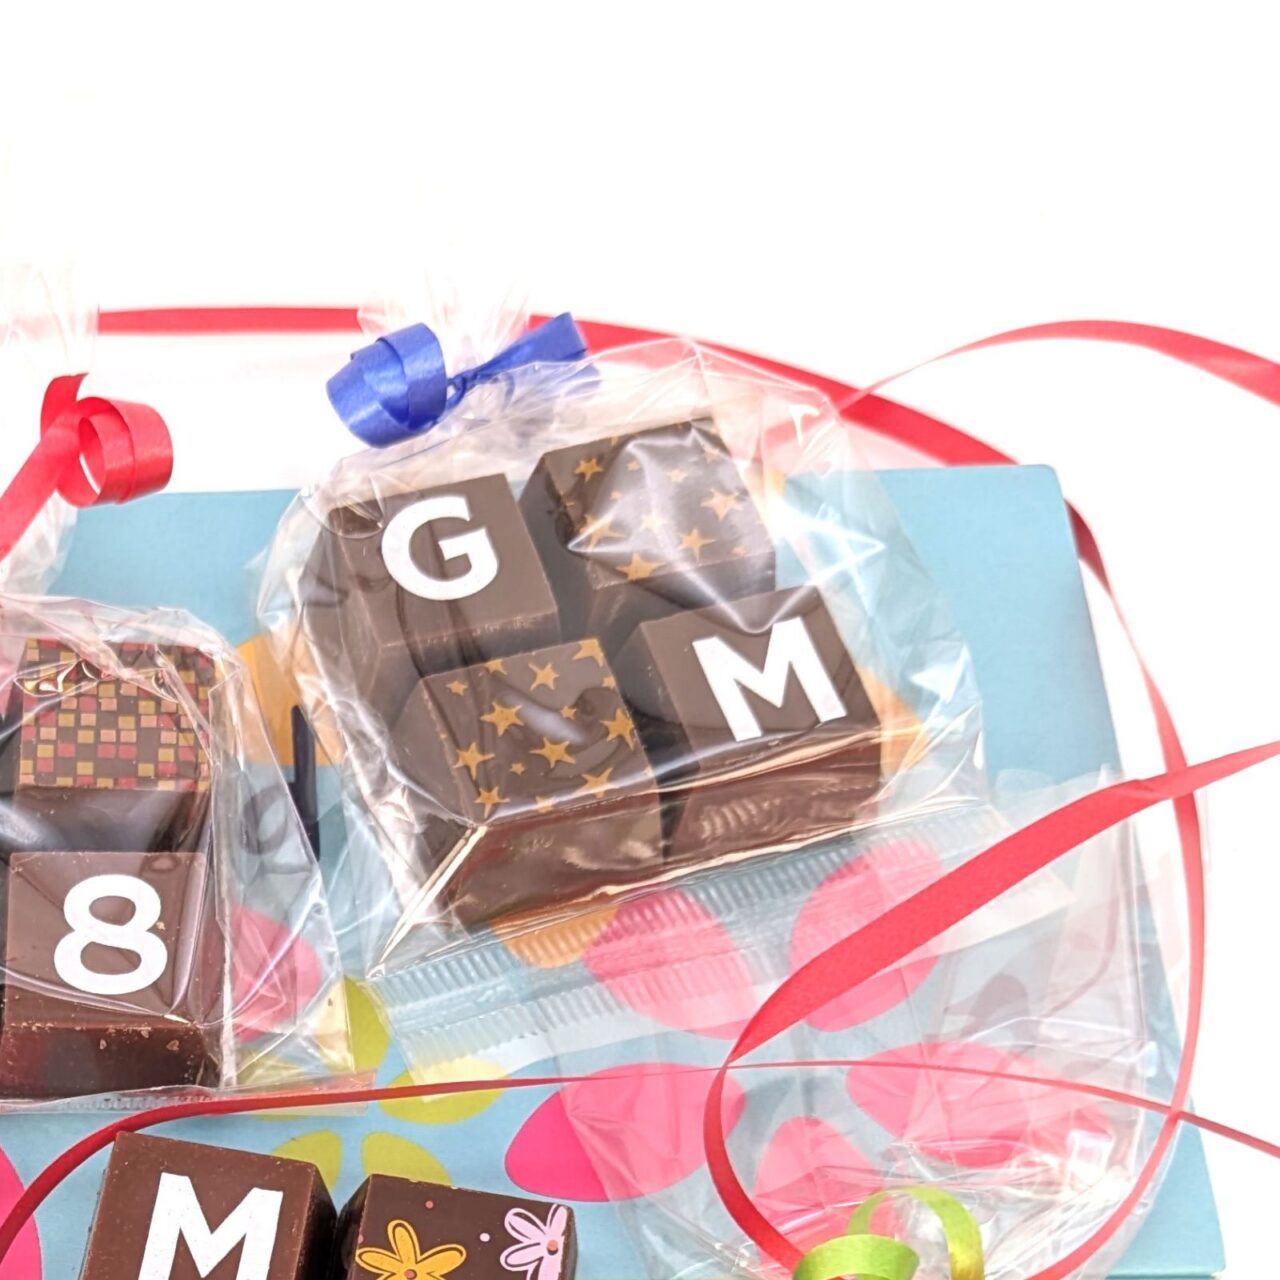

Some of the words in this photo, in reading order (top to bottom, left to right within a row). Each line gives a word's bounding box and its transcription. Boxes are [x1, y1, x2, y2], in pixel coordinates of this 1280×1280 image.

[382, 496, 497, 600] G
[692, 617, 846, 742] M
[54, 874, 167, 994] 8
